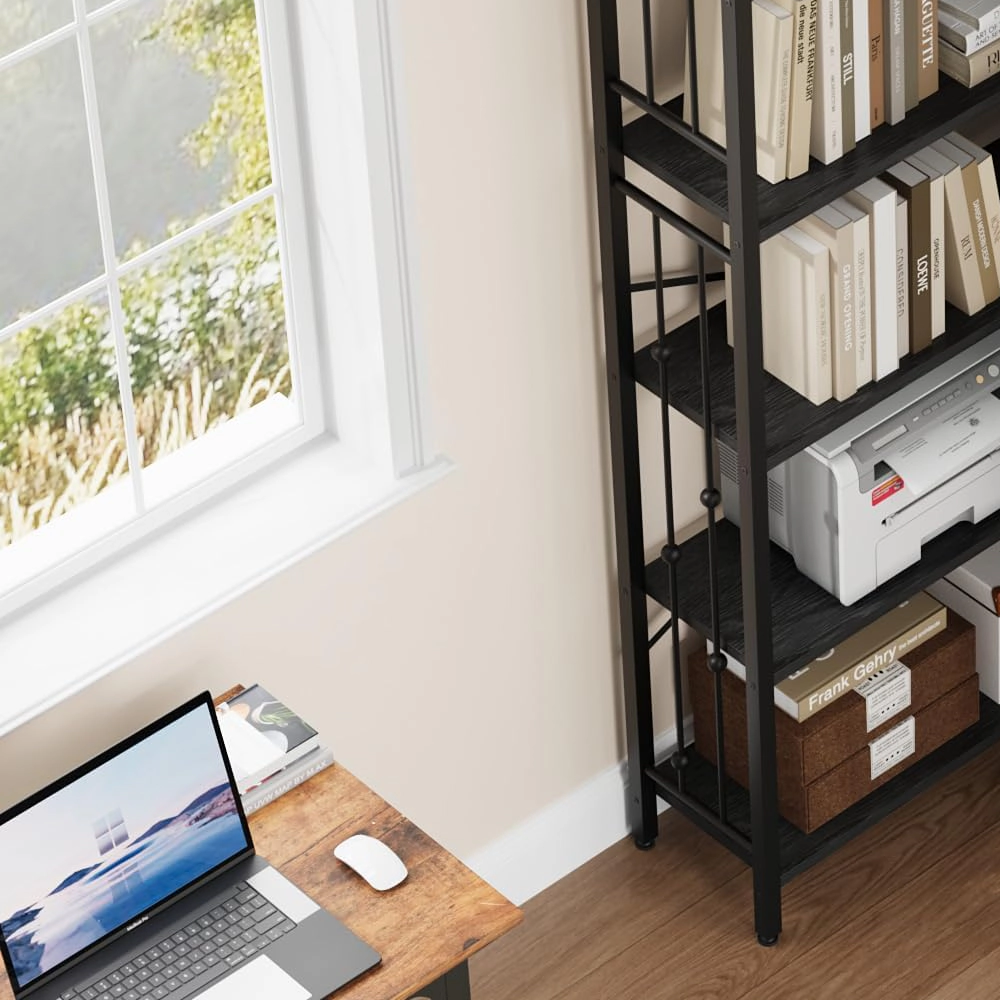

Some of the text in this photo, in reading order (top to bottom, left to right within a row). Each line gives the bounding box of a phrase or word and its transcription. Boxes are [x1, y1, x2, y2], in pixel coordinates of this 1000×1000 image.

[796, 4, 807, 65] die neue stadt
[805, 0, 818, 102] DAS NEUE FRANKFURT
[870, 34, 881, 63] Paris
[975, 29, 987, 42] ART
[988, 22, 998, 34] OF
[976, 35, 989, 47] AND
[842, 53, 853, 85] STILL
[917, 255, 929, 295] LOEWE
[841, 264, 853, 352] GRAND OPENING
[808, 676, 850, 711] Frank
[853, 645, 898, 681] Gehry
